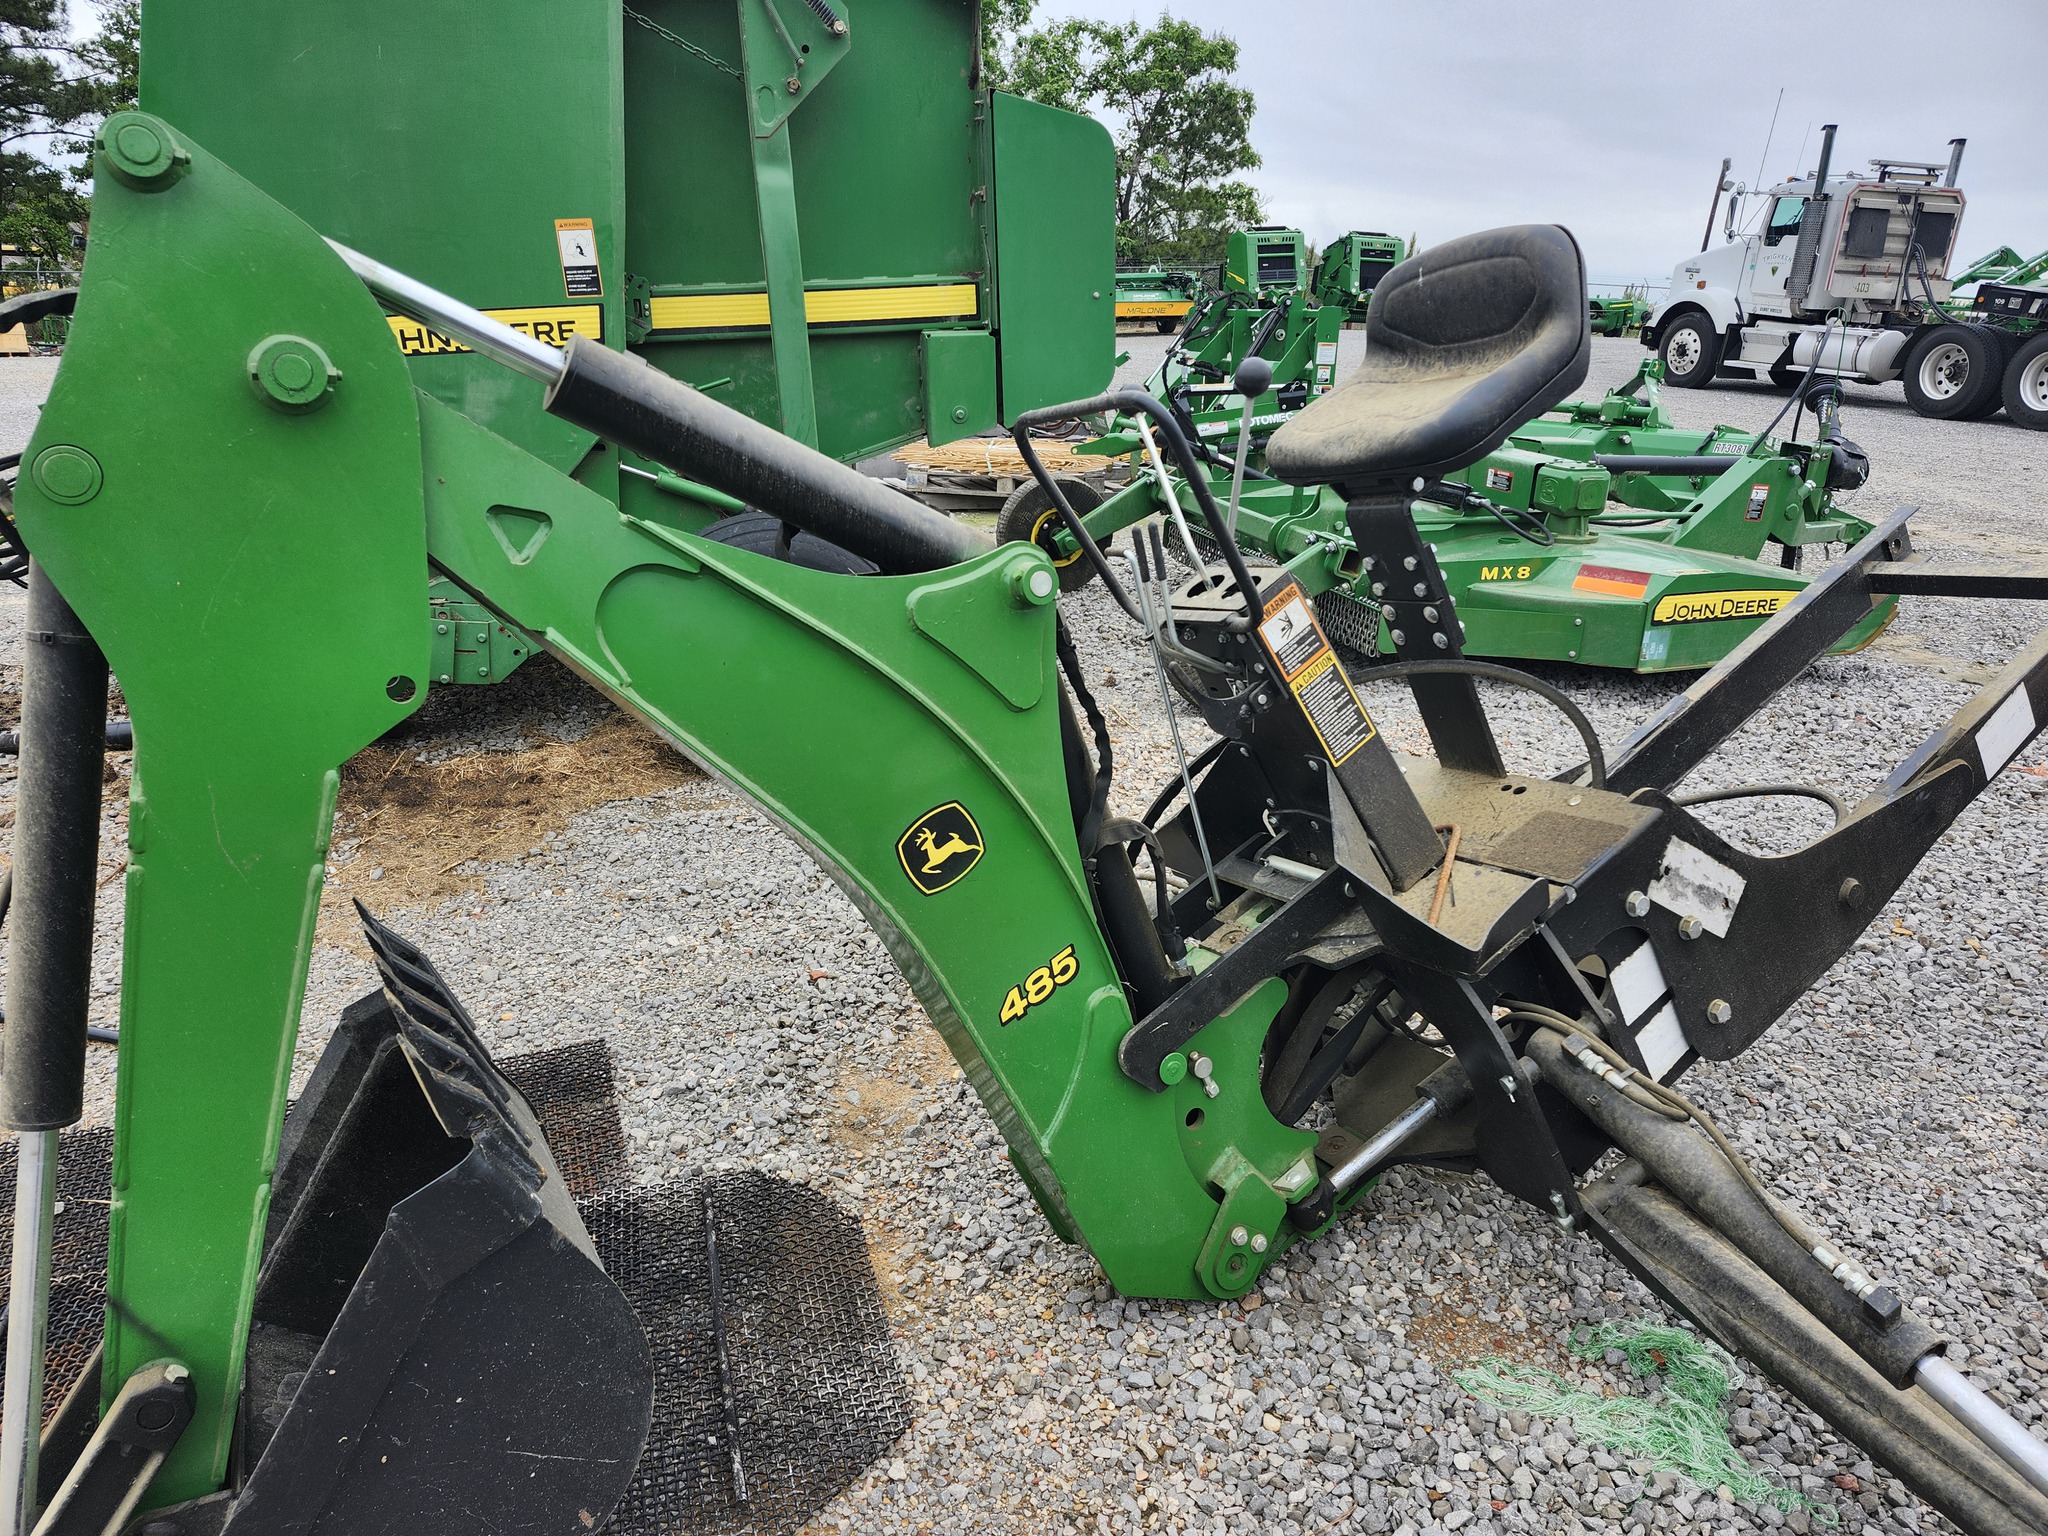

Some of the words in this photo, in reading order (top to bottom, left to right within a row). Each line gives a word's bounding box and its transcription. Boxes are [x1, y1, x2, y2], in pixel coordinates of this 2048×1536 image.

[1763, 253, 1792, 263] TRIGREEN
[1855, 283, 1870, 293] 403
[399, 328, 452, 350] HN
[1713, 443, 1748, 454] RT3081
[1264, 586, 1298, 618] WARNING
[1665, 602, 1717, 620] JOHN
[1720, 598, 1780, 615] DEERE
[1301, 654, 1334, 684] CAUTION
[999, 944, 1080, 1026] 485
